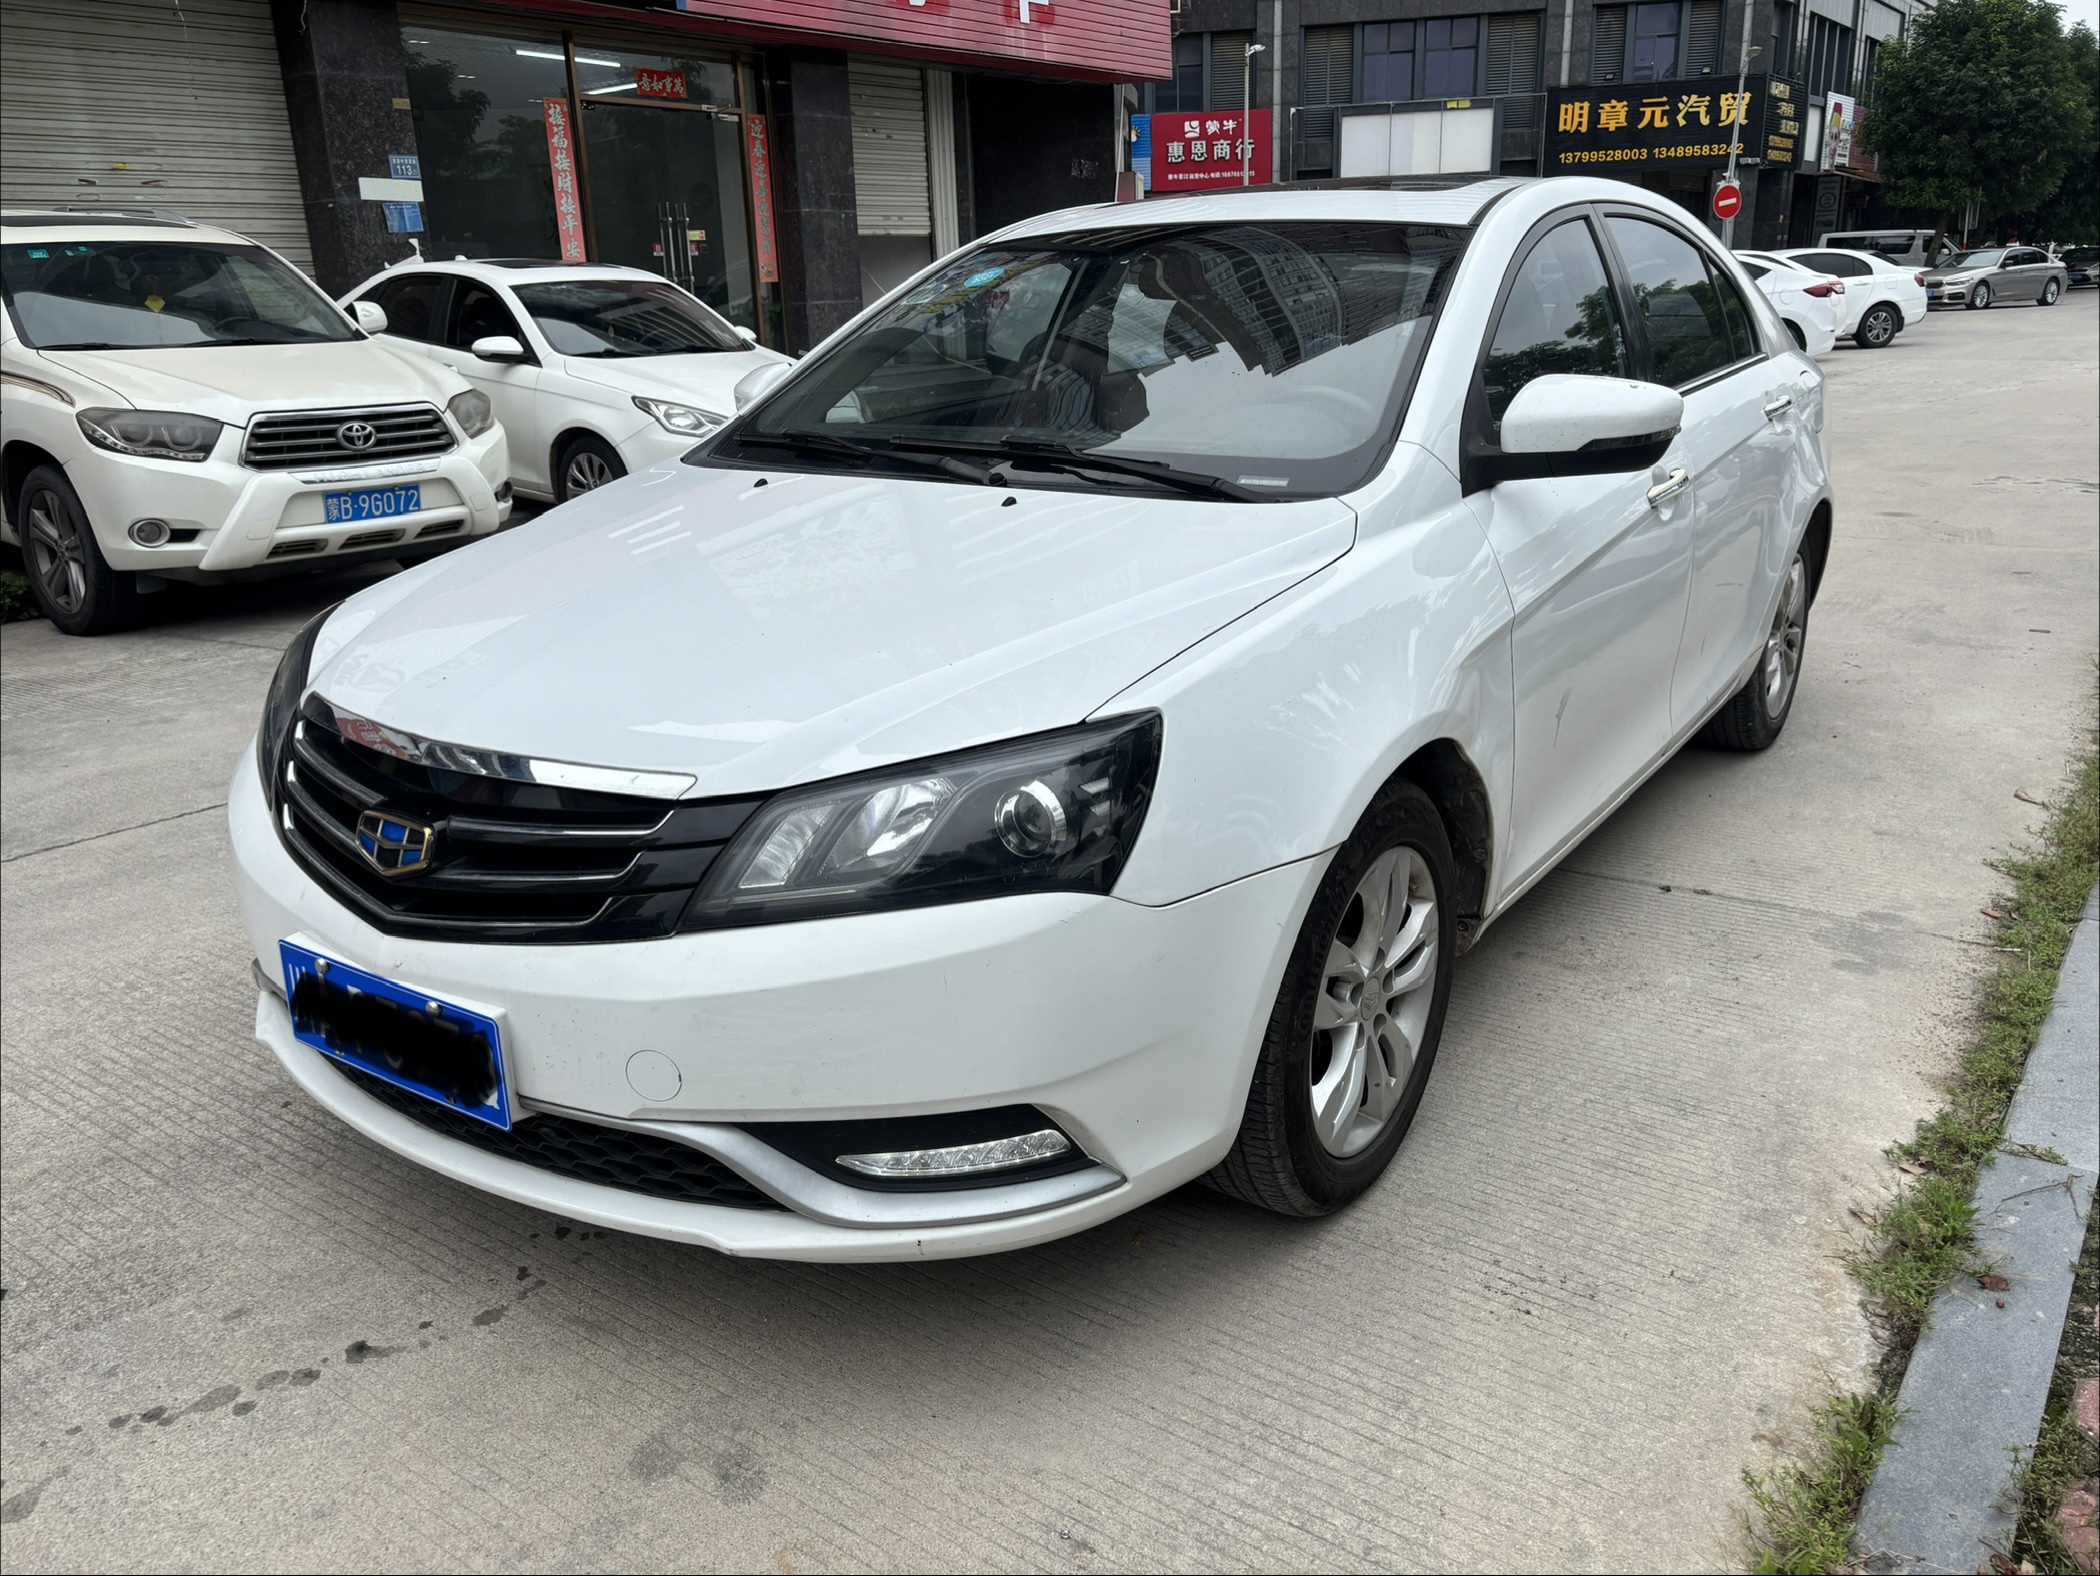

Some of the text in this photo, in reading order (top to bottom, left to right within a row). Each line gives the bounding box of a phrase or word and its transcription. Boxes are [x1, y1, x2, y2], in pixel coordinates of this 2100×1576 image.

[1558, 91, 1752, 133] 明章元汽贸
[1205, 119, 1238, 135] 蒙牛
[1166, 138, 1255, 163] 惠恩商行
[1559, 149, 1648, 164] 13799528003
[396, 164, 412, 176] 113
